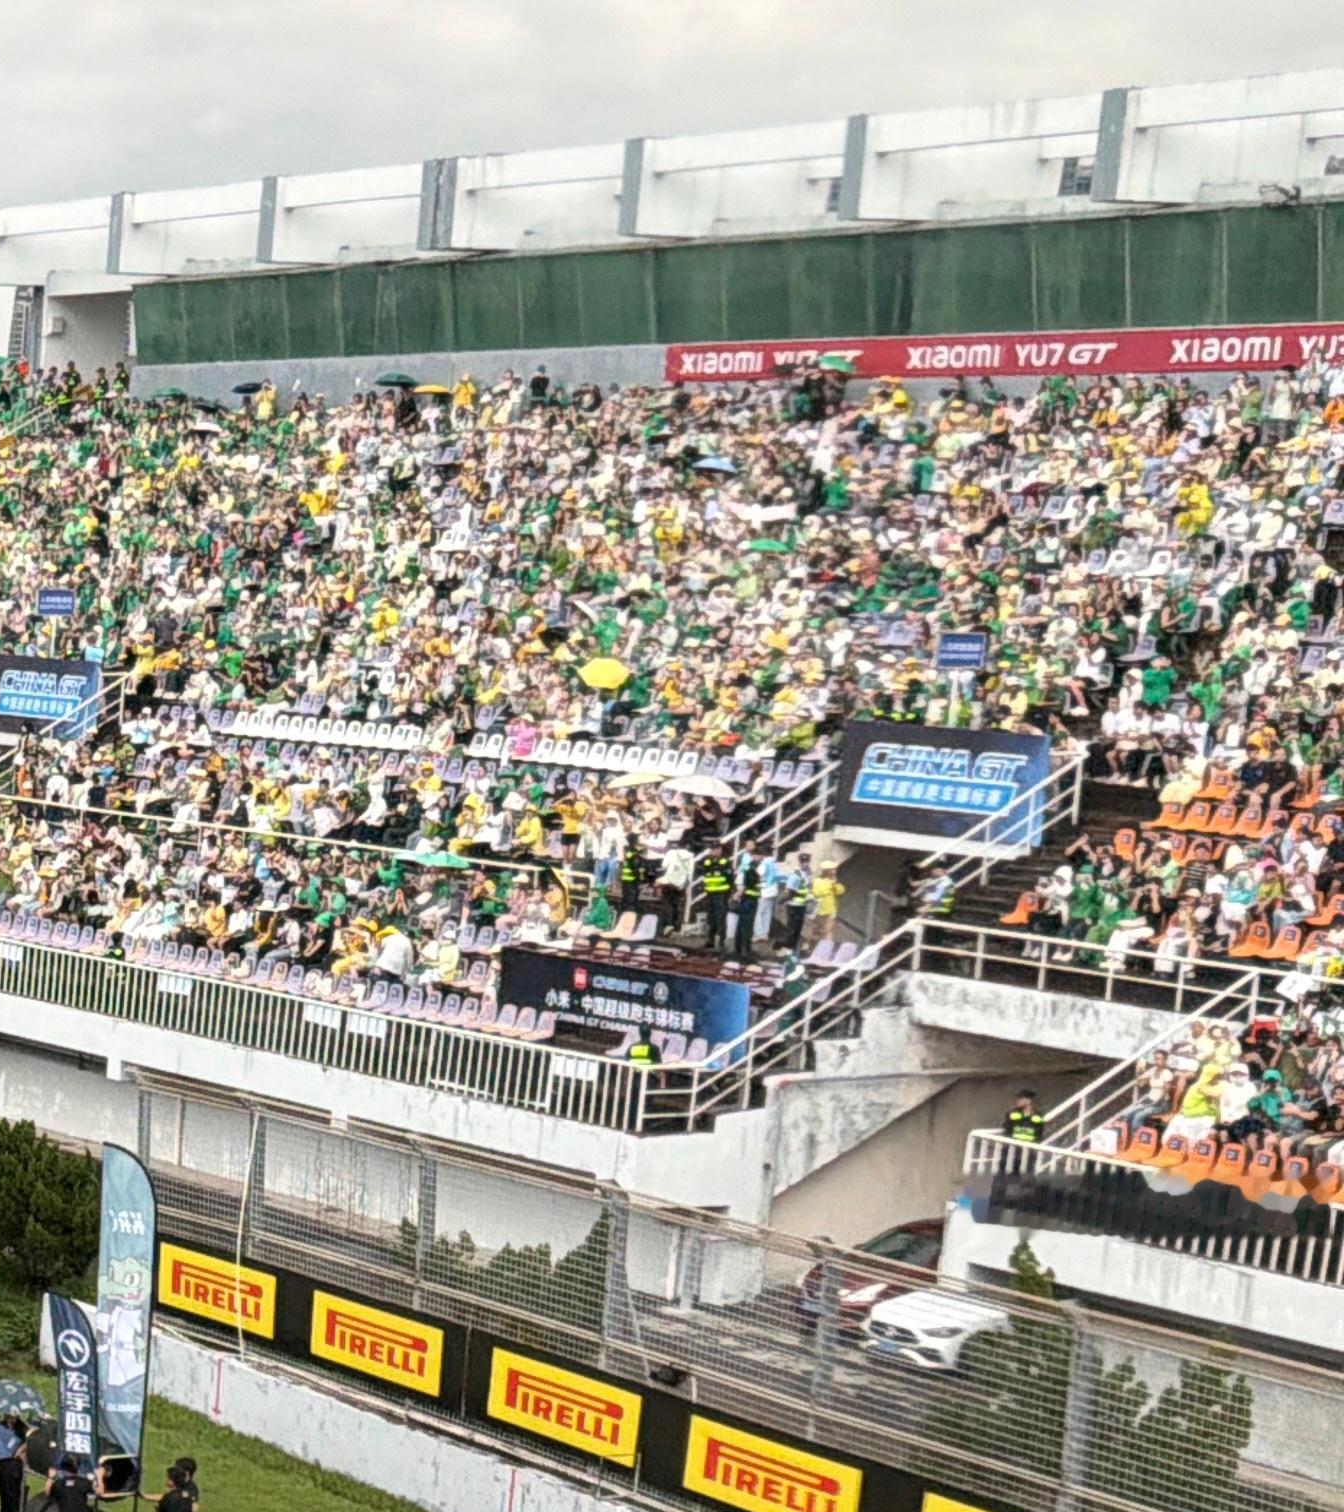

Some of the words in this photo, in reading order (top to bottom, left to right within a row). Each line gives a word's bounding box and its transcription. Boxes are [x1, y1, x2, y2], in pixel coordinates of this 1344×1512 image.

[1015, 343, 1063, 366] YU7
[1068, 342, 1118, 364] GT
[863, 742, 971, 778] CHINA
[973, 752, 1029, 785] GT
[172, 1259, 263, 1322] PIRELLI
[325, 1309, 428, 1377] PIRELLI
[505, 1367, 624, 1446] PIRELLI
